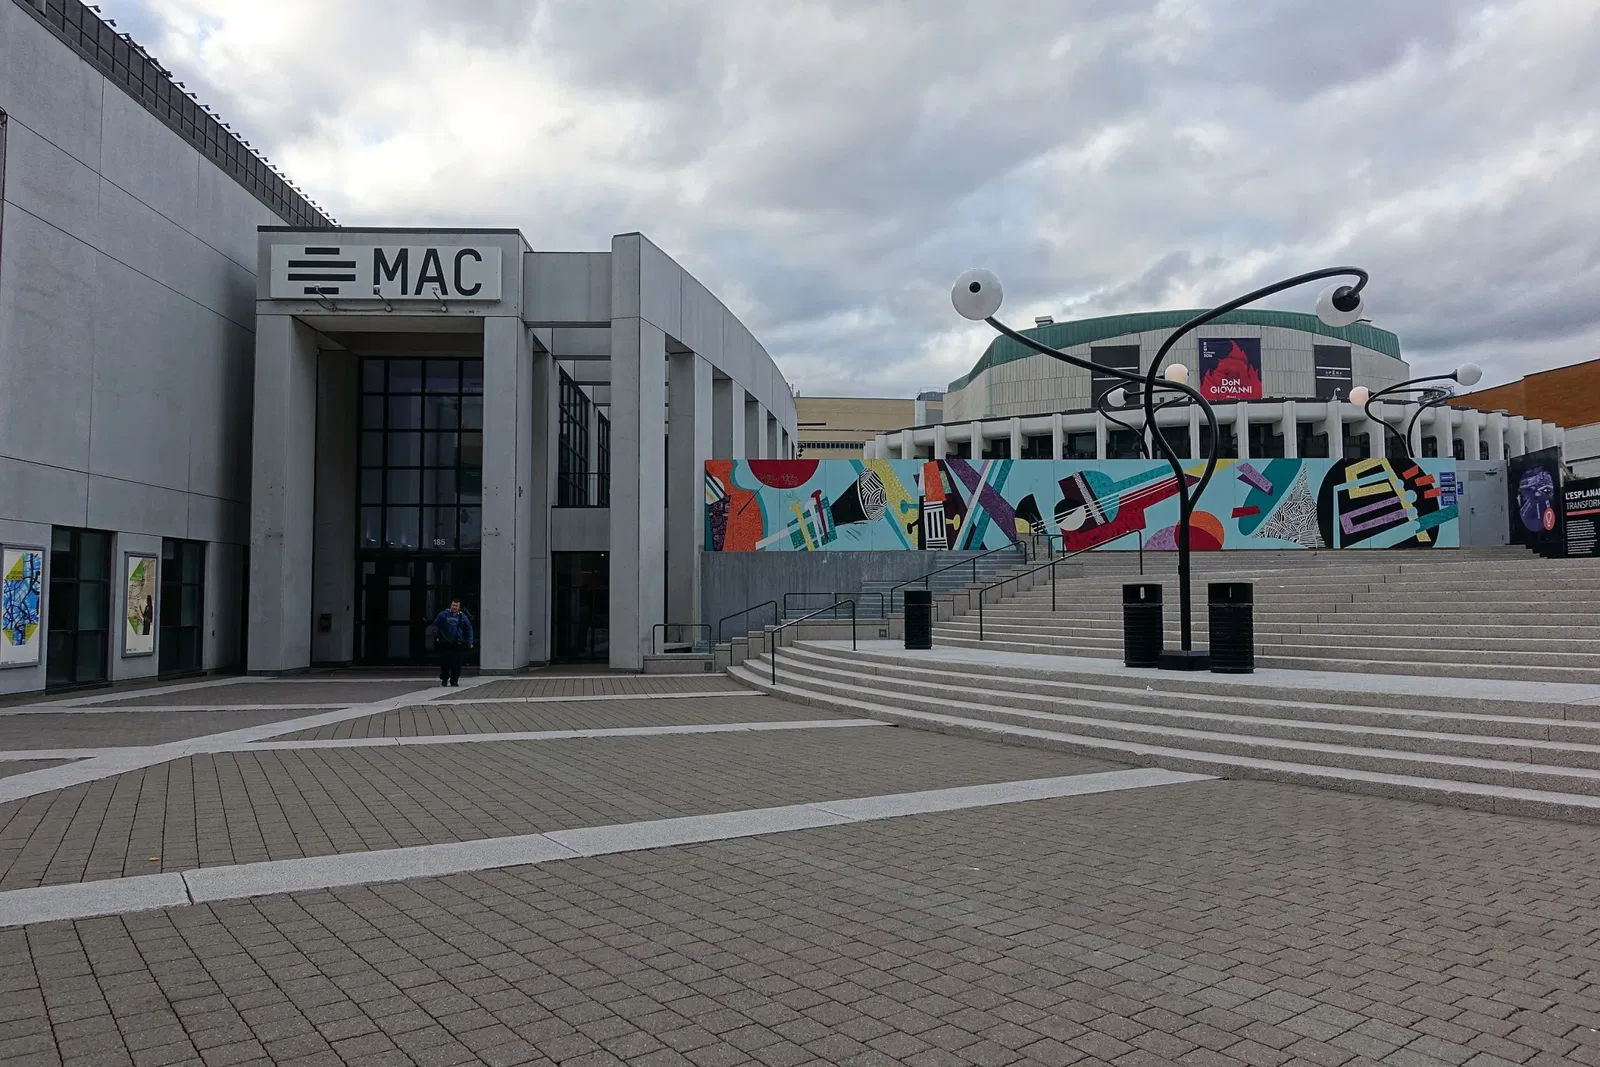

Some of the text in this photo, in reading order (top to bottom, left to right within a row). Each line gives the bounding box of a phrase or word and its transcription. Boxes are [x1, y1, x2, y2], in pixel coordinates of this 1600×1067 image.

[373, 247, 483, 296] MAC
[1210, 386, 1252, 394] GIOVANNI
[433, 538, 446, 546] 185
